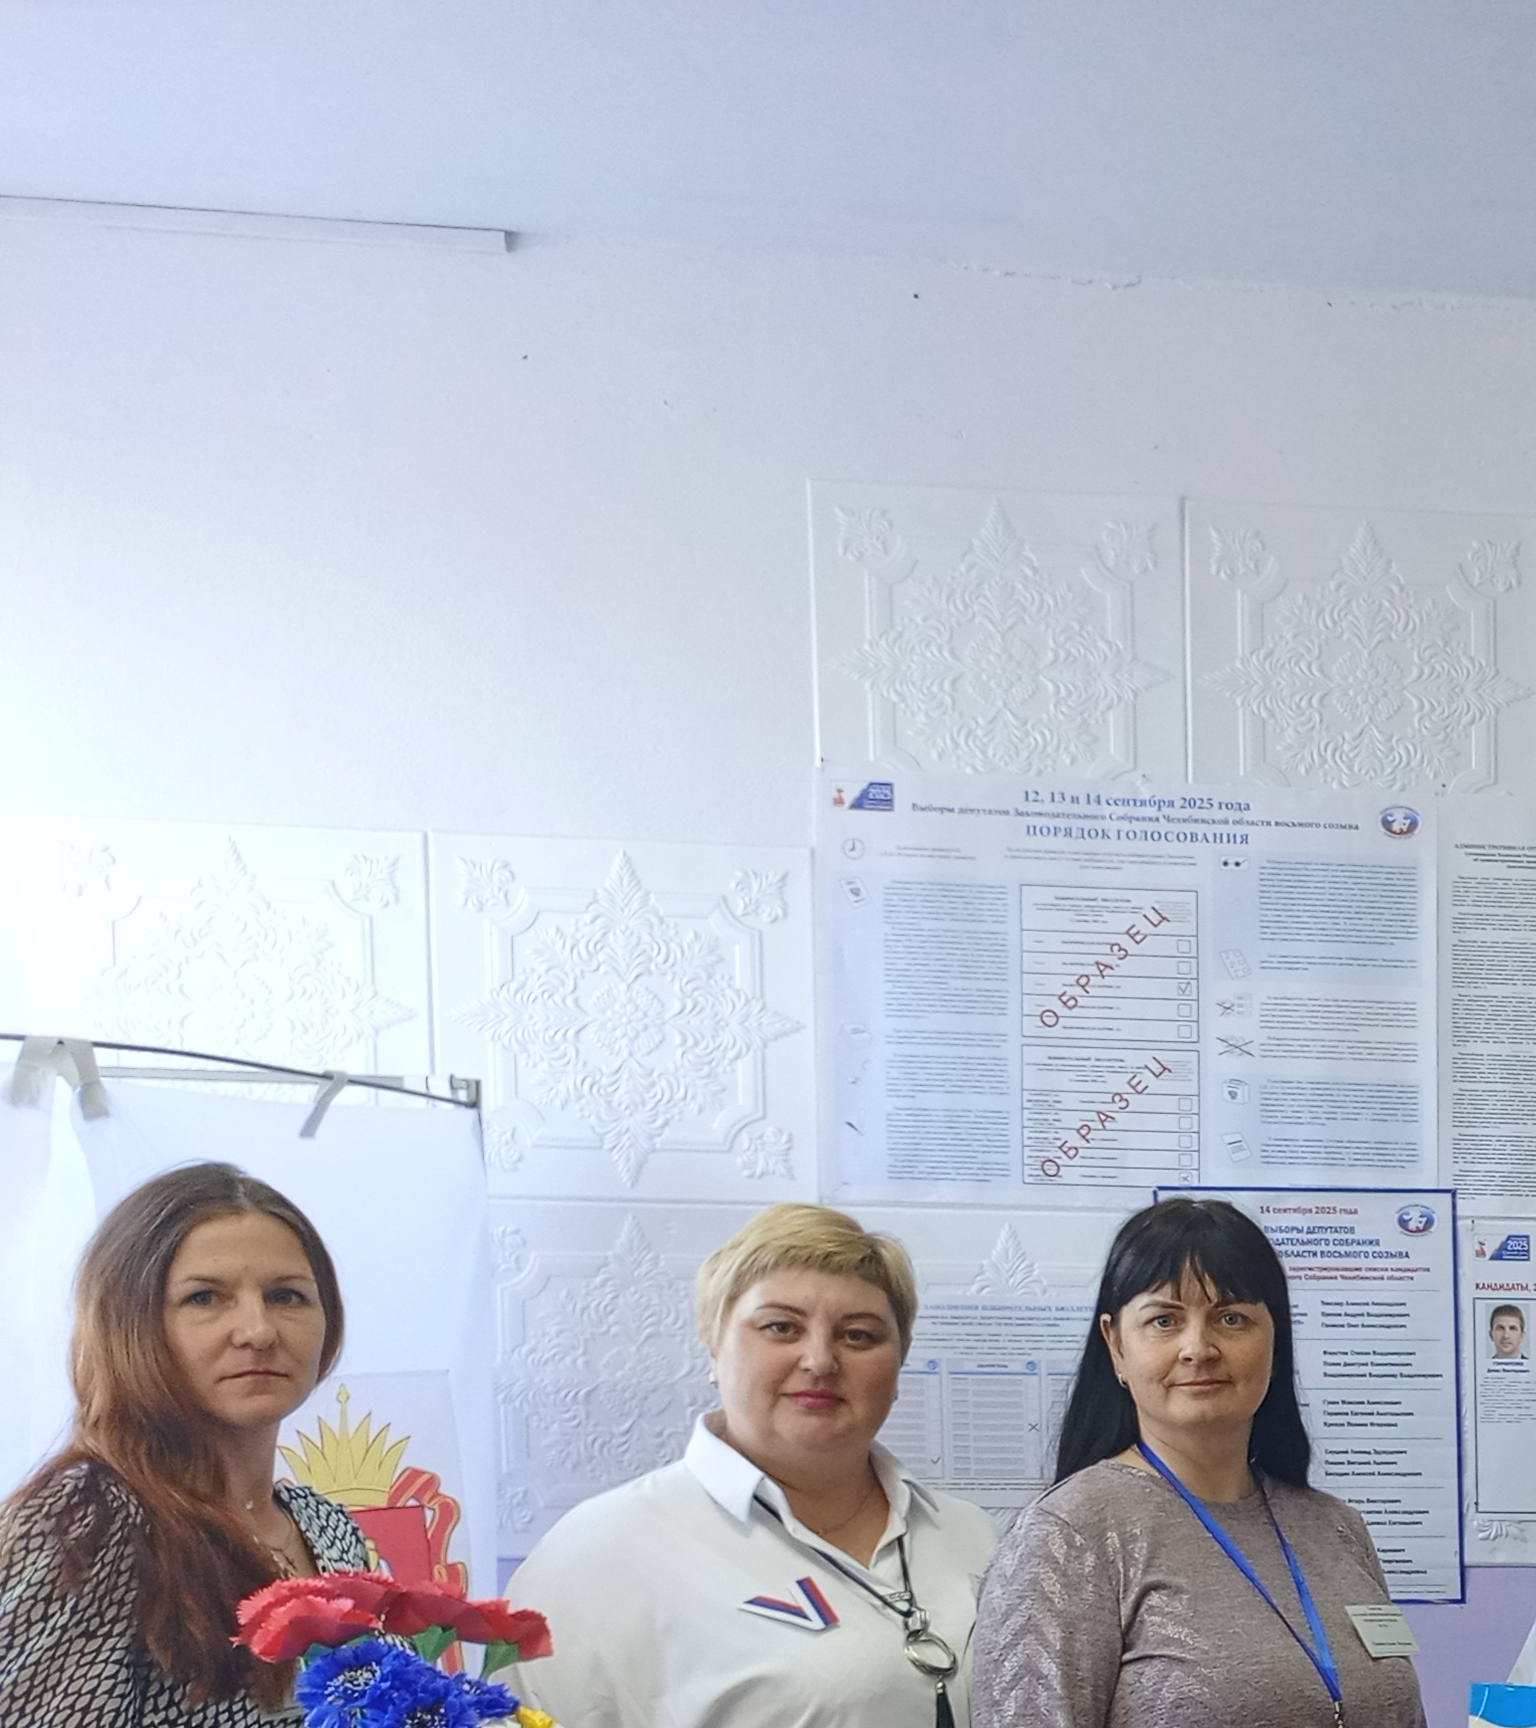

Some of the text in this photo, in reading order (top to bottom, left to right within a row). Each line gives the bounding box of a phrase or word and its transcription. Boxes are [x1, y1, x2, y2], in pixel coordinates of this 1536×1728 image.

[1024, 789, 1043, 805] 12,
[1050, 791, 1066, 805] 13
[1085, 792, 1102, 806] 14
[1105, 794, 1175, 811] сентября
[1179, 796, 1214, 811] 2025
[1217, 799, 1251, 813] года
[1109, 811, 1161, 826] Собрания
[1162, 813, 1230, 828] Челябинской
[1231, 815, 1273, 828] области
[1025, 824, 1251, 847] ПОРЯДОК ГОЛОСОВАНИЯ
[1040, 906, 1171, 1028] ОБРАЗЕЦ
[1041, 1056, 1173, 1178] ОБРАЗЕЦ
[1259, 1206, 1359, 1217] 14 сентября 2025 года
[1305, 1226, 1356, 1236] ДЕПУТАТОВ
[1332, 1238, 1381, 1248] СОБРАНИЯ
[1507, 1240, 1529, 1250] 2025
[1320, 1250, 1370, 1260] ВОСЬМОГО
[1371, 1250, 1411, 1260] СОЗЫВА
[1303, 1273, 1339, 1283] Собрания
[1475, 1282, 1531, 1293] КАНДИДАТЫ,
